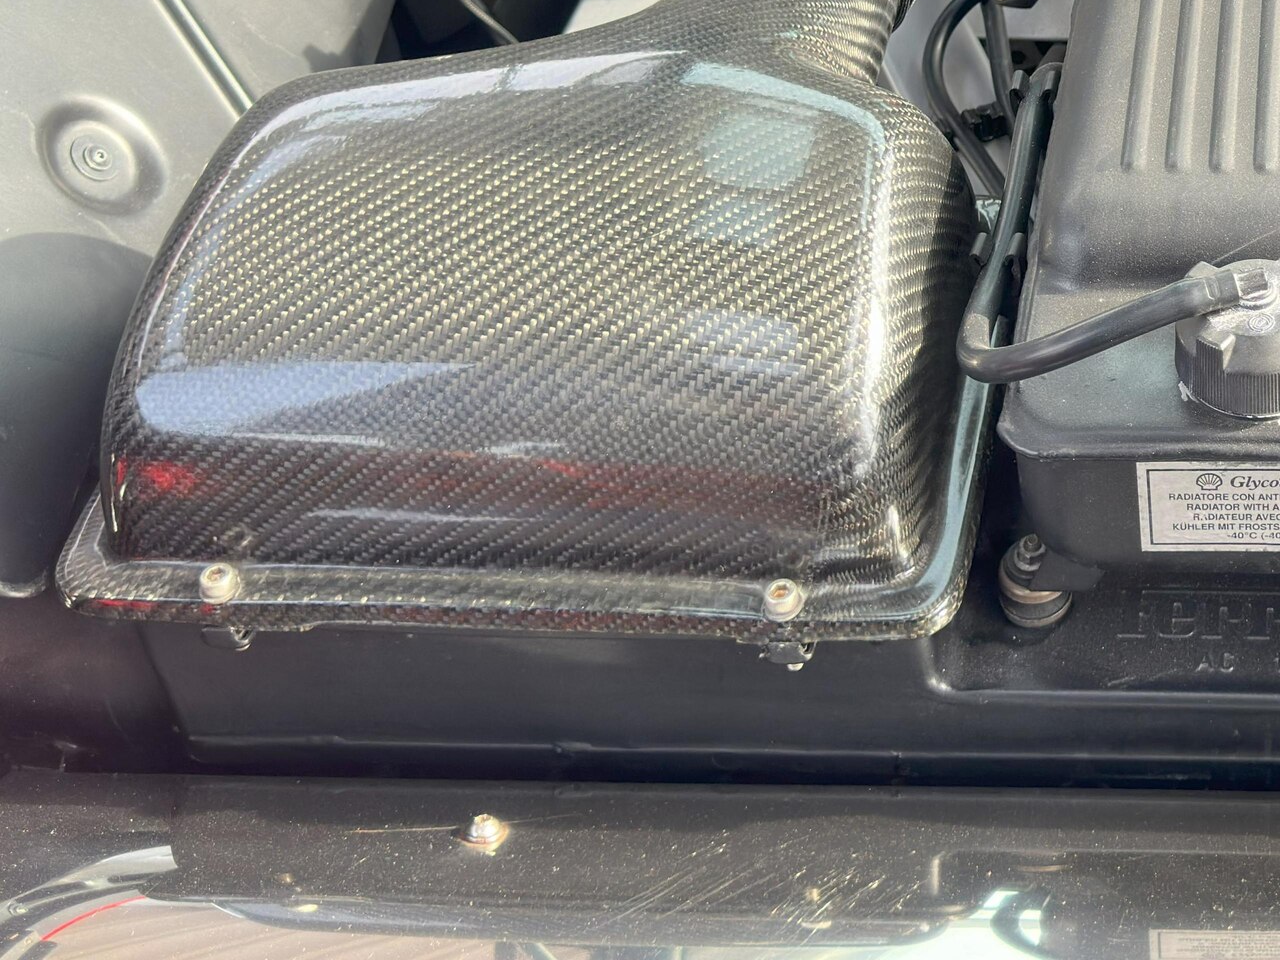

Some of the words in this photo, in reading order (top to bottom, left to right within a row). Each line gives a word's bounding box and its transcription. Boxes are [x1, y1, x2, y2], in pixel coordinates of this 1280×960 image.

[1168, 493, 1229, 501] RADIATORE
[1232, 493, 1255, 501] CON
[1186, 503, 1240, 511] RADIATOR
[1243, 503, 1270, 511] WITH
[1172, 522, 1215, 531] KÜHLER
[1217, 523, 1236, 531] MIT
[1227, 531, 1258, 539] -40°C
